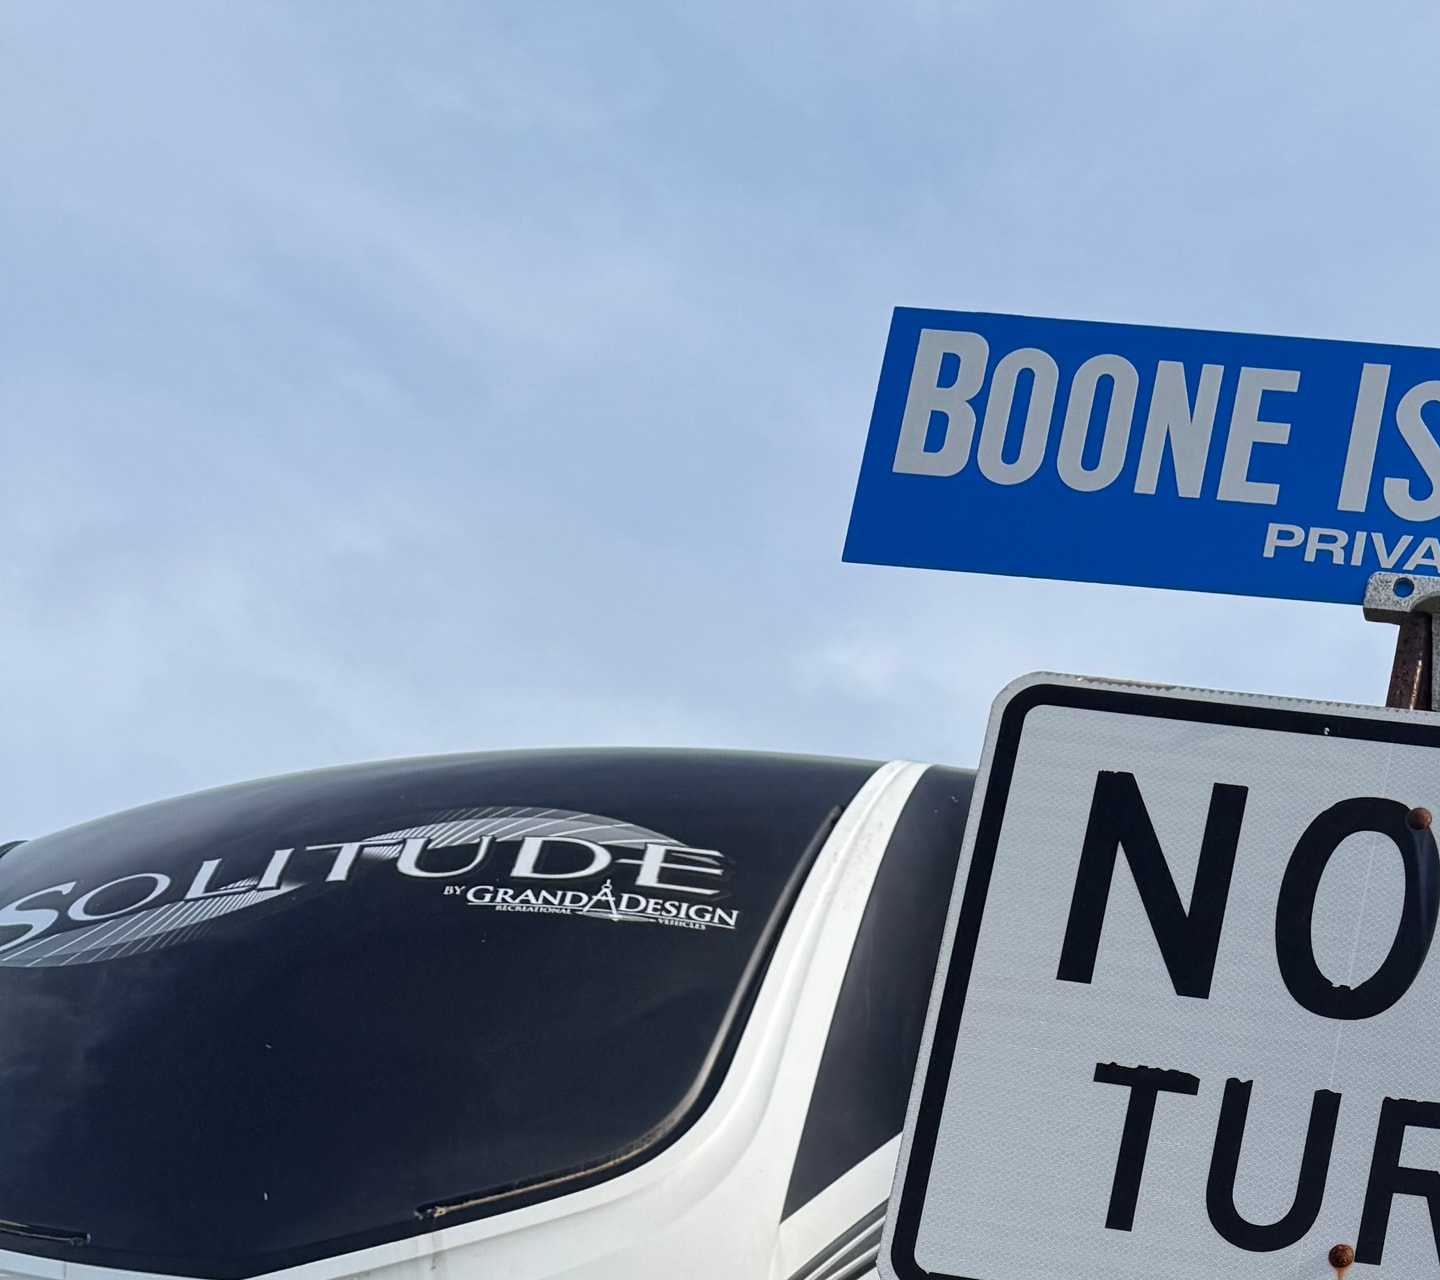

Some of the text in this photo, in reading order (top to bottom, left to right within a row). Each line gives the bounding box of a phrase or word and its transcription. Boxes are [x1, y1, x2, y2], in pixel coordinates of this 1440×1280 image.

[893, 327, 1299, 506] BOONE
[0, 834, 726, 952] SOLITUDE
[443, 885, 740, 927] BY GRAND DESIGN
